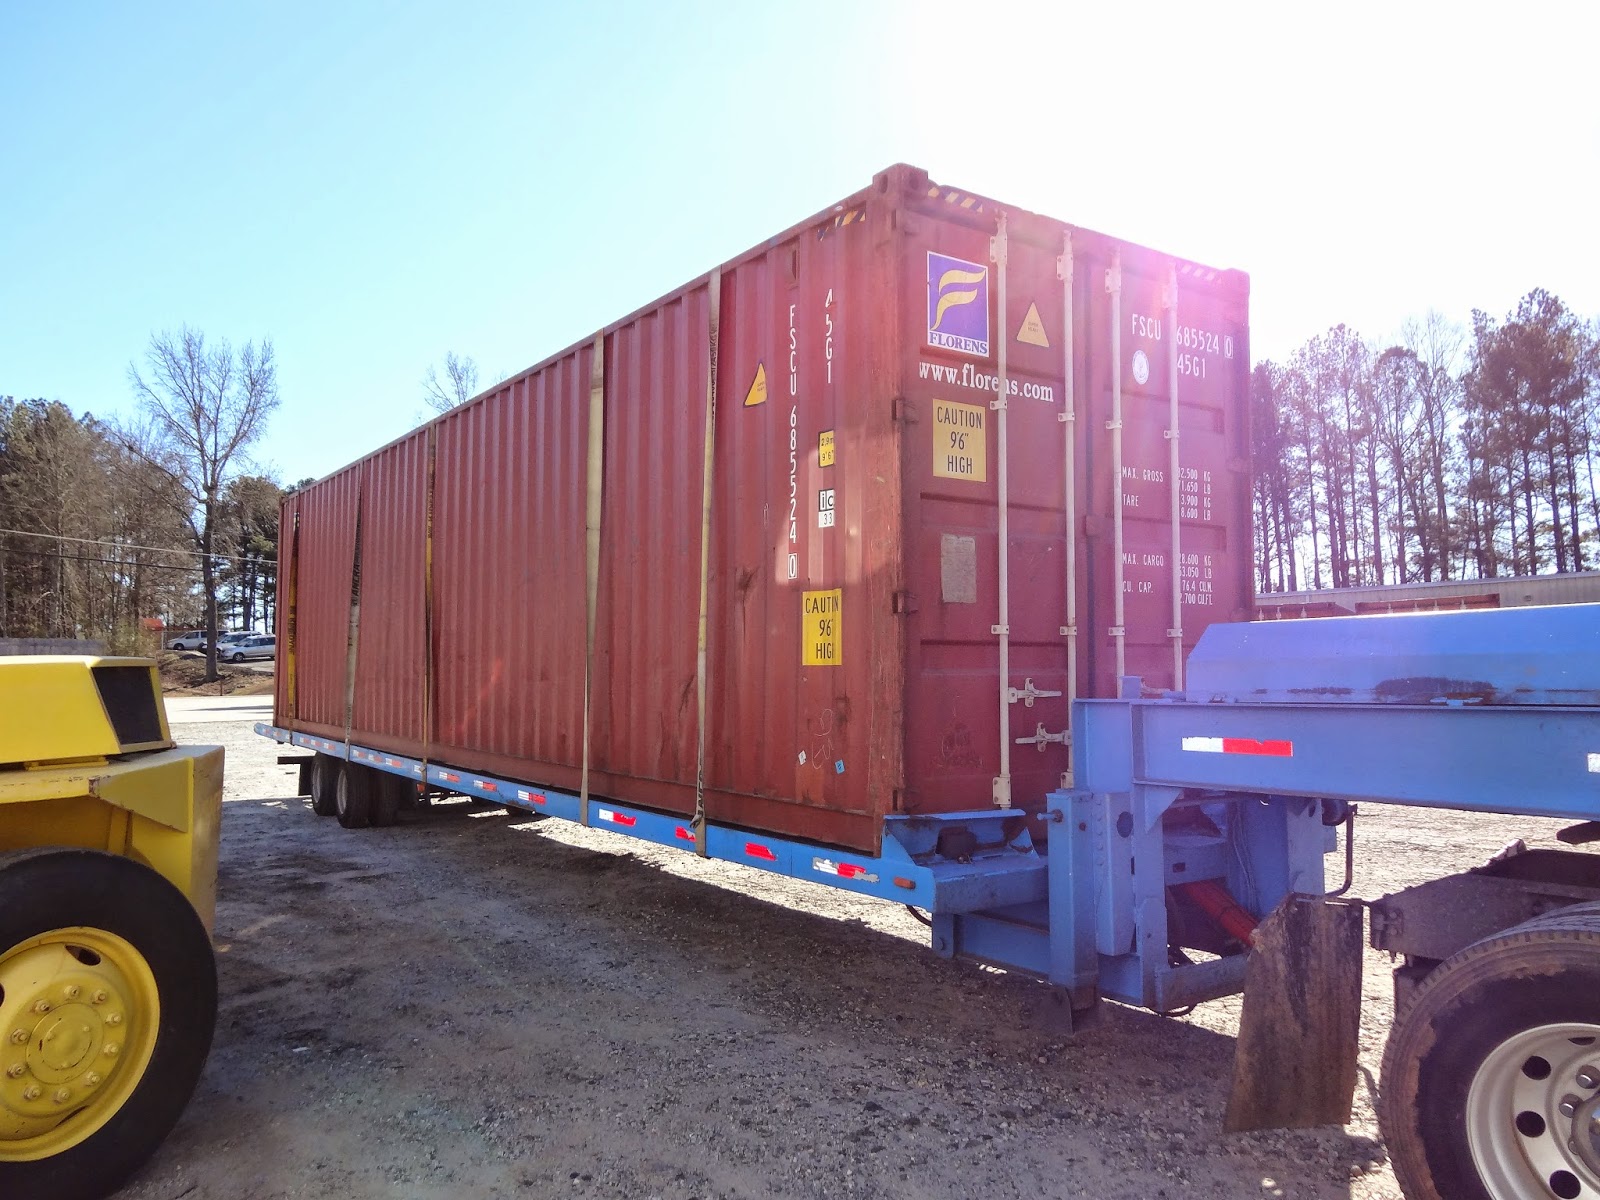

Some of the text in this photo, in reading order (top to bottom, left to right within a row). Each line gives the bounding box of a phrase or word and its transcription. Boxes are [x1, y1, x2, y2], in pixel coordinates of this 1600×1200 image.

[825, 288, 833, 384] 45G1
[929, 332, 988, 354] FLORENS
[1132, 313, 1232, 358] FSCU 685524 0
[1177, 353, 1206, 378] 45G1
[937, 406, 982, 429] CAUTION
[789, 304, 797, 578] FSCU 685524 0
[950, 431, 969, 450] 9'6"
[947, 454, 973, 474] HIGH
[1122, 466, 1139, 479] MAX.
[1143, 469, 1164, 482] GROSS
[1203, 470, 1211, 482] KG
[1203, 483, 1211, 495] LB
[1122, 494, 1139, 507] TARE
[1203, 496, 1211, 508] KG
[823, 512, 833, 525] 33
[1203, 509, 1211, 521] LB
[1122, 553, 1212, 567] MAX. CARGO 8.600 KG
[1204, 567, 1212, 579] LB
[1138, 581, 1154, 593] CAP.
[1182, 580, 1196, 592] 76.4
[815, 642, 834, 660] HIG
